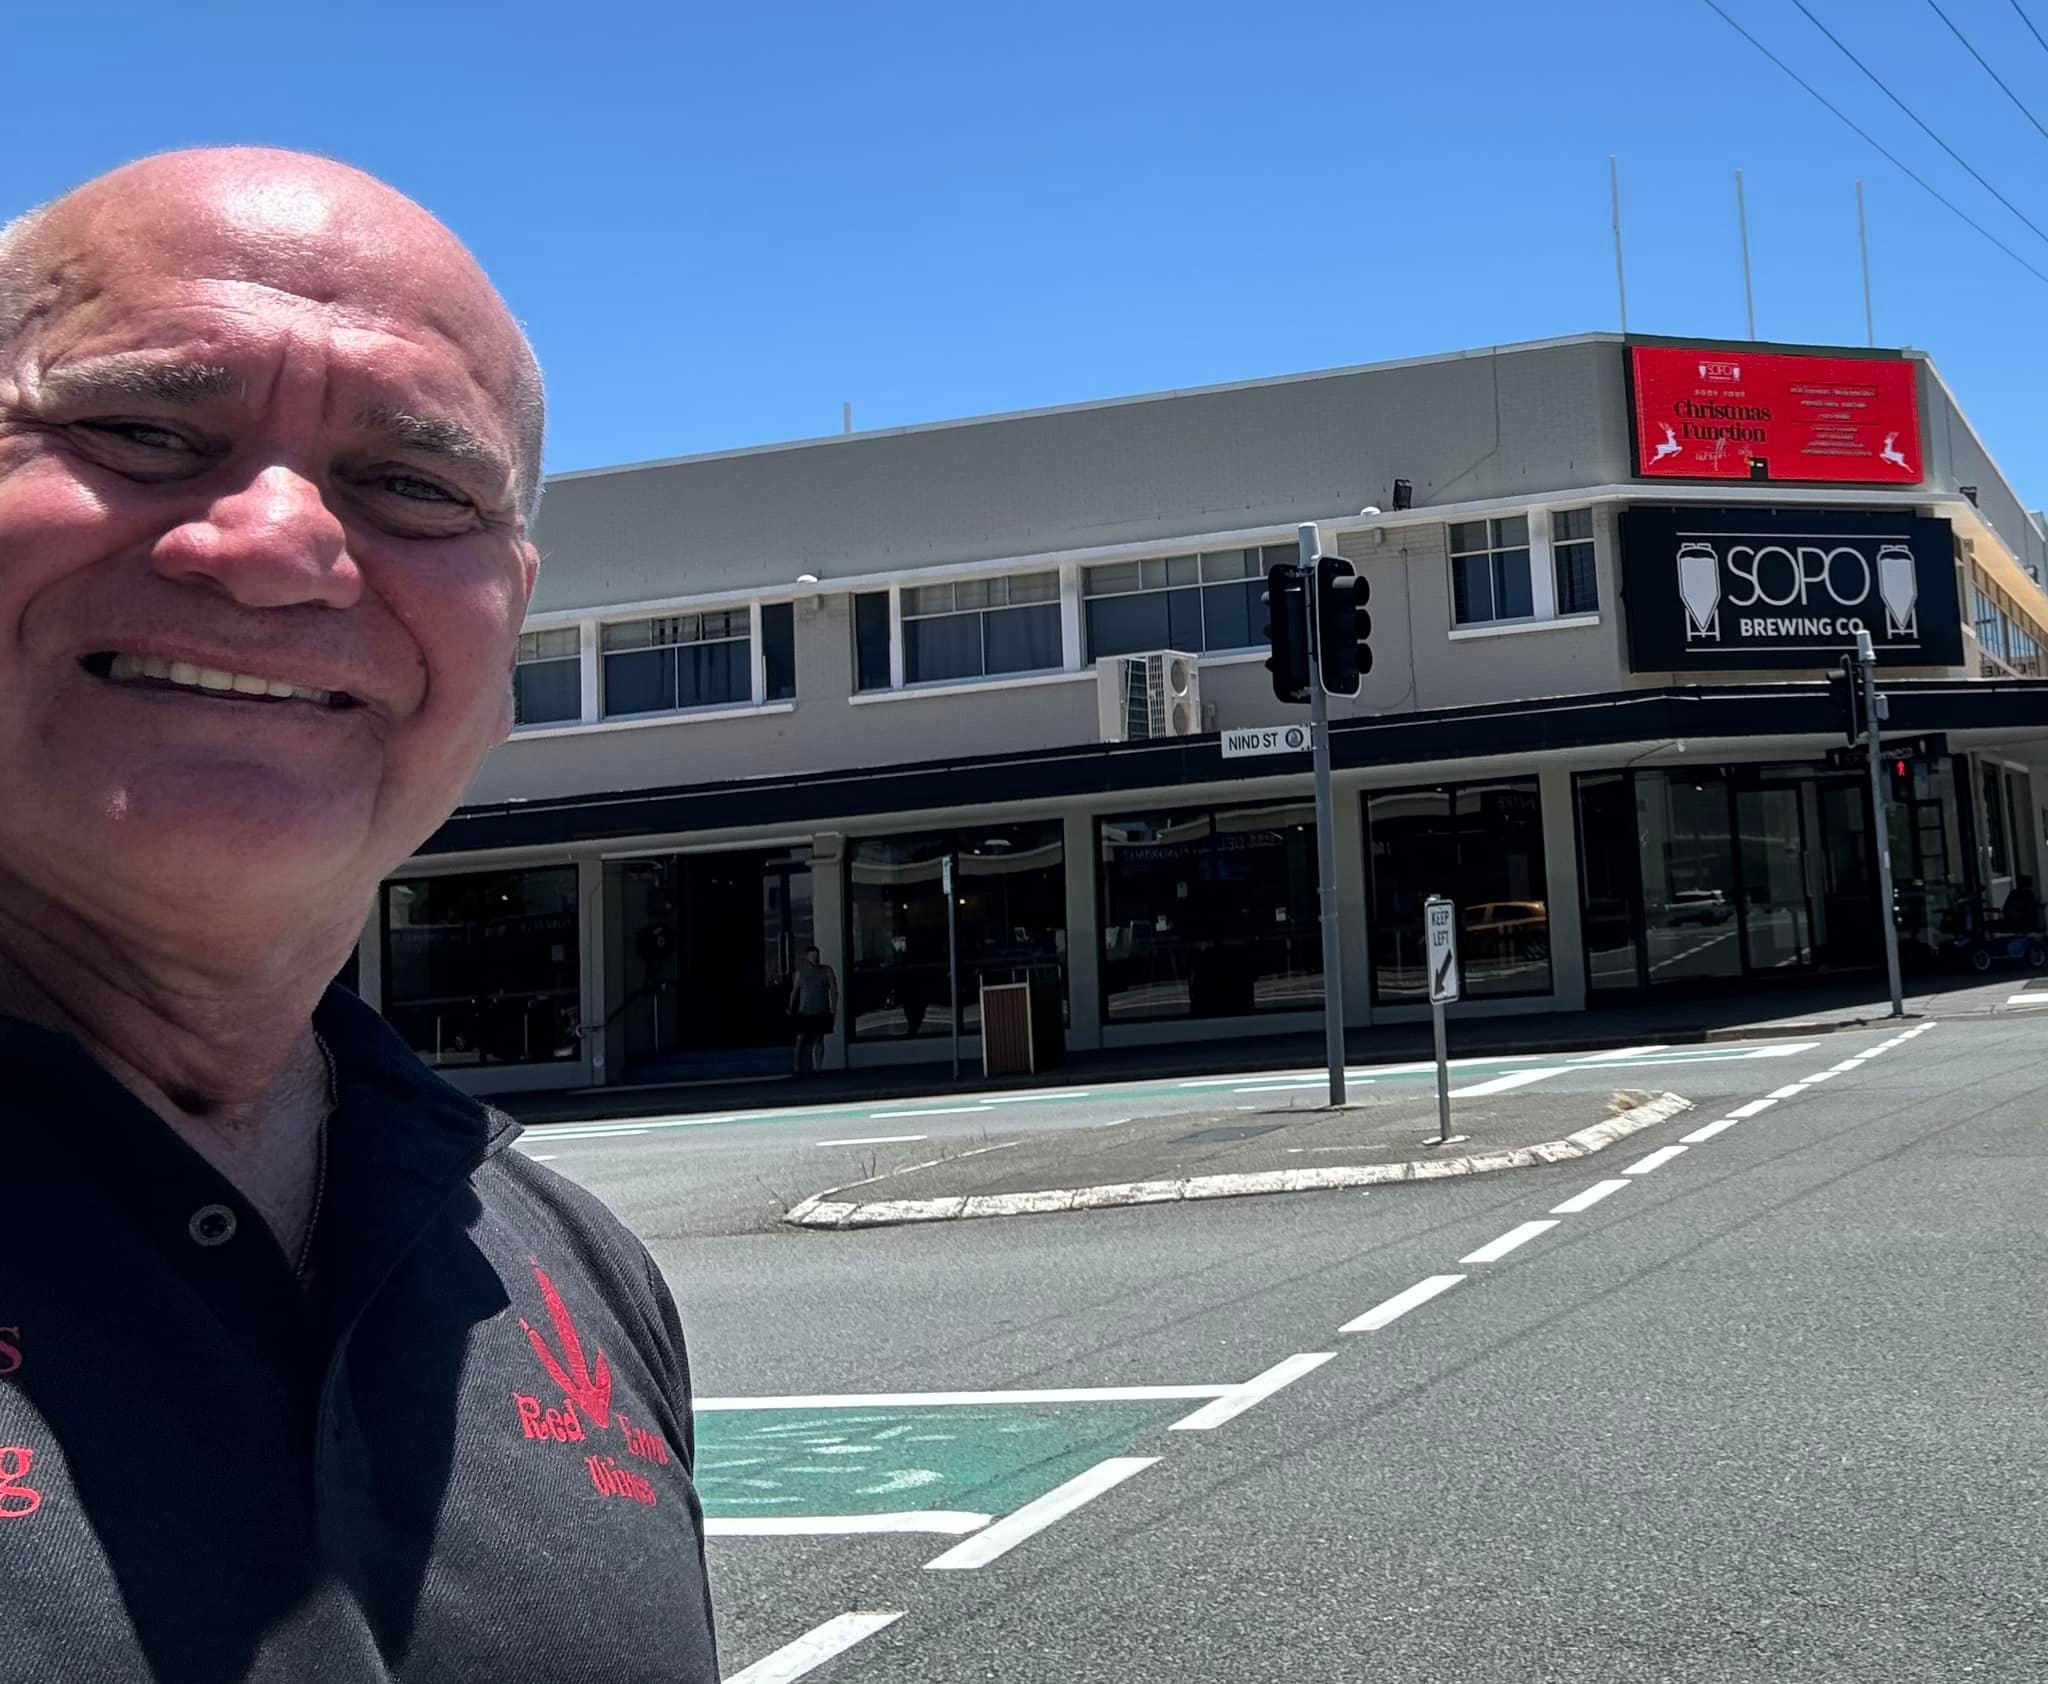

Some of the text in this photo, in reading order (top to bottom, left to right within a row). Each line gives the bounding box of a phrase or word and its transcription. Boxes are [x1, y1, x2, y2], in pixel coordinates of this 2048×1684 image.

[1673, 399, 1772, 421] Christmas
[1683, 422, 1767, 442] Function
[1727, 545, 1871, 606] SOPO
[1740, 618, 1832, 637] BREWING
[1228, 732, 1278, 751] NIND ST
[1432, 910, 1449, 926] KEEP
[1433, 930, 1449, 946] LEFT
[513, 1392, 585, 1441] Red
